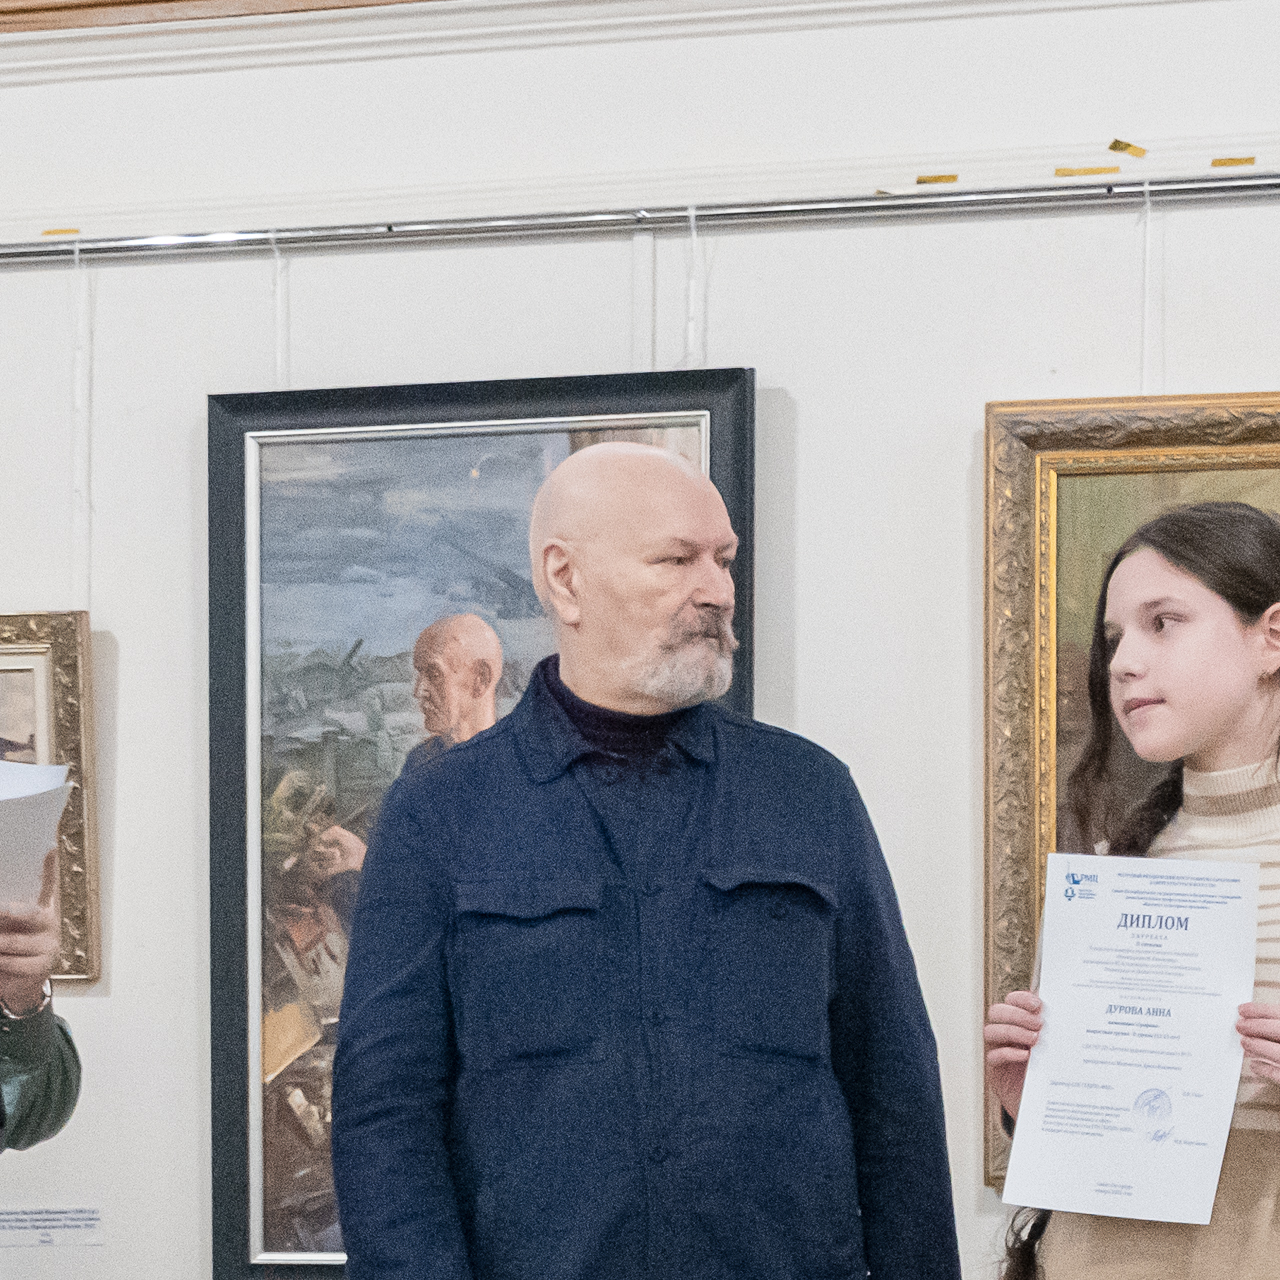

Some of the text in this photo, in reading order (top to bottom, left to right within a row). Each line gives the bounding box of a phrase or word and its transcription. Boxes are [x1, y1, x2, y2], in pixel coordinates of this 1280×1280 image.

[1117, 913, 1190, 931] ДИПЛОМ
[1105, 1004, 1172, 1018] ДУРОВА АННА
